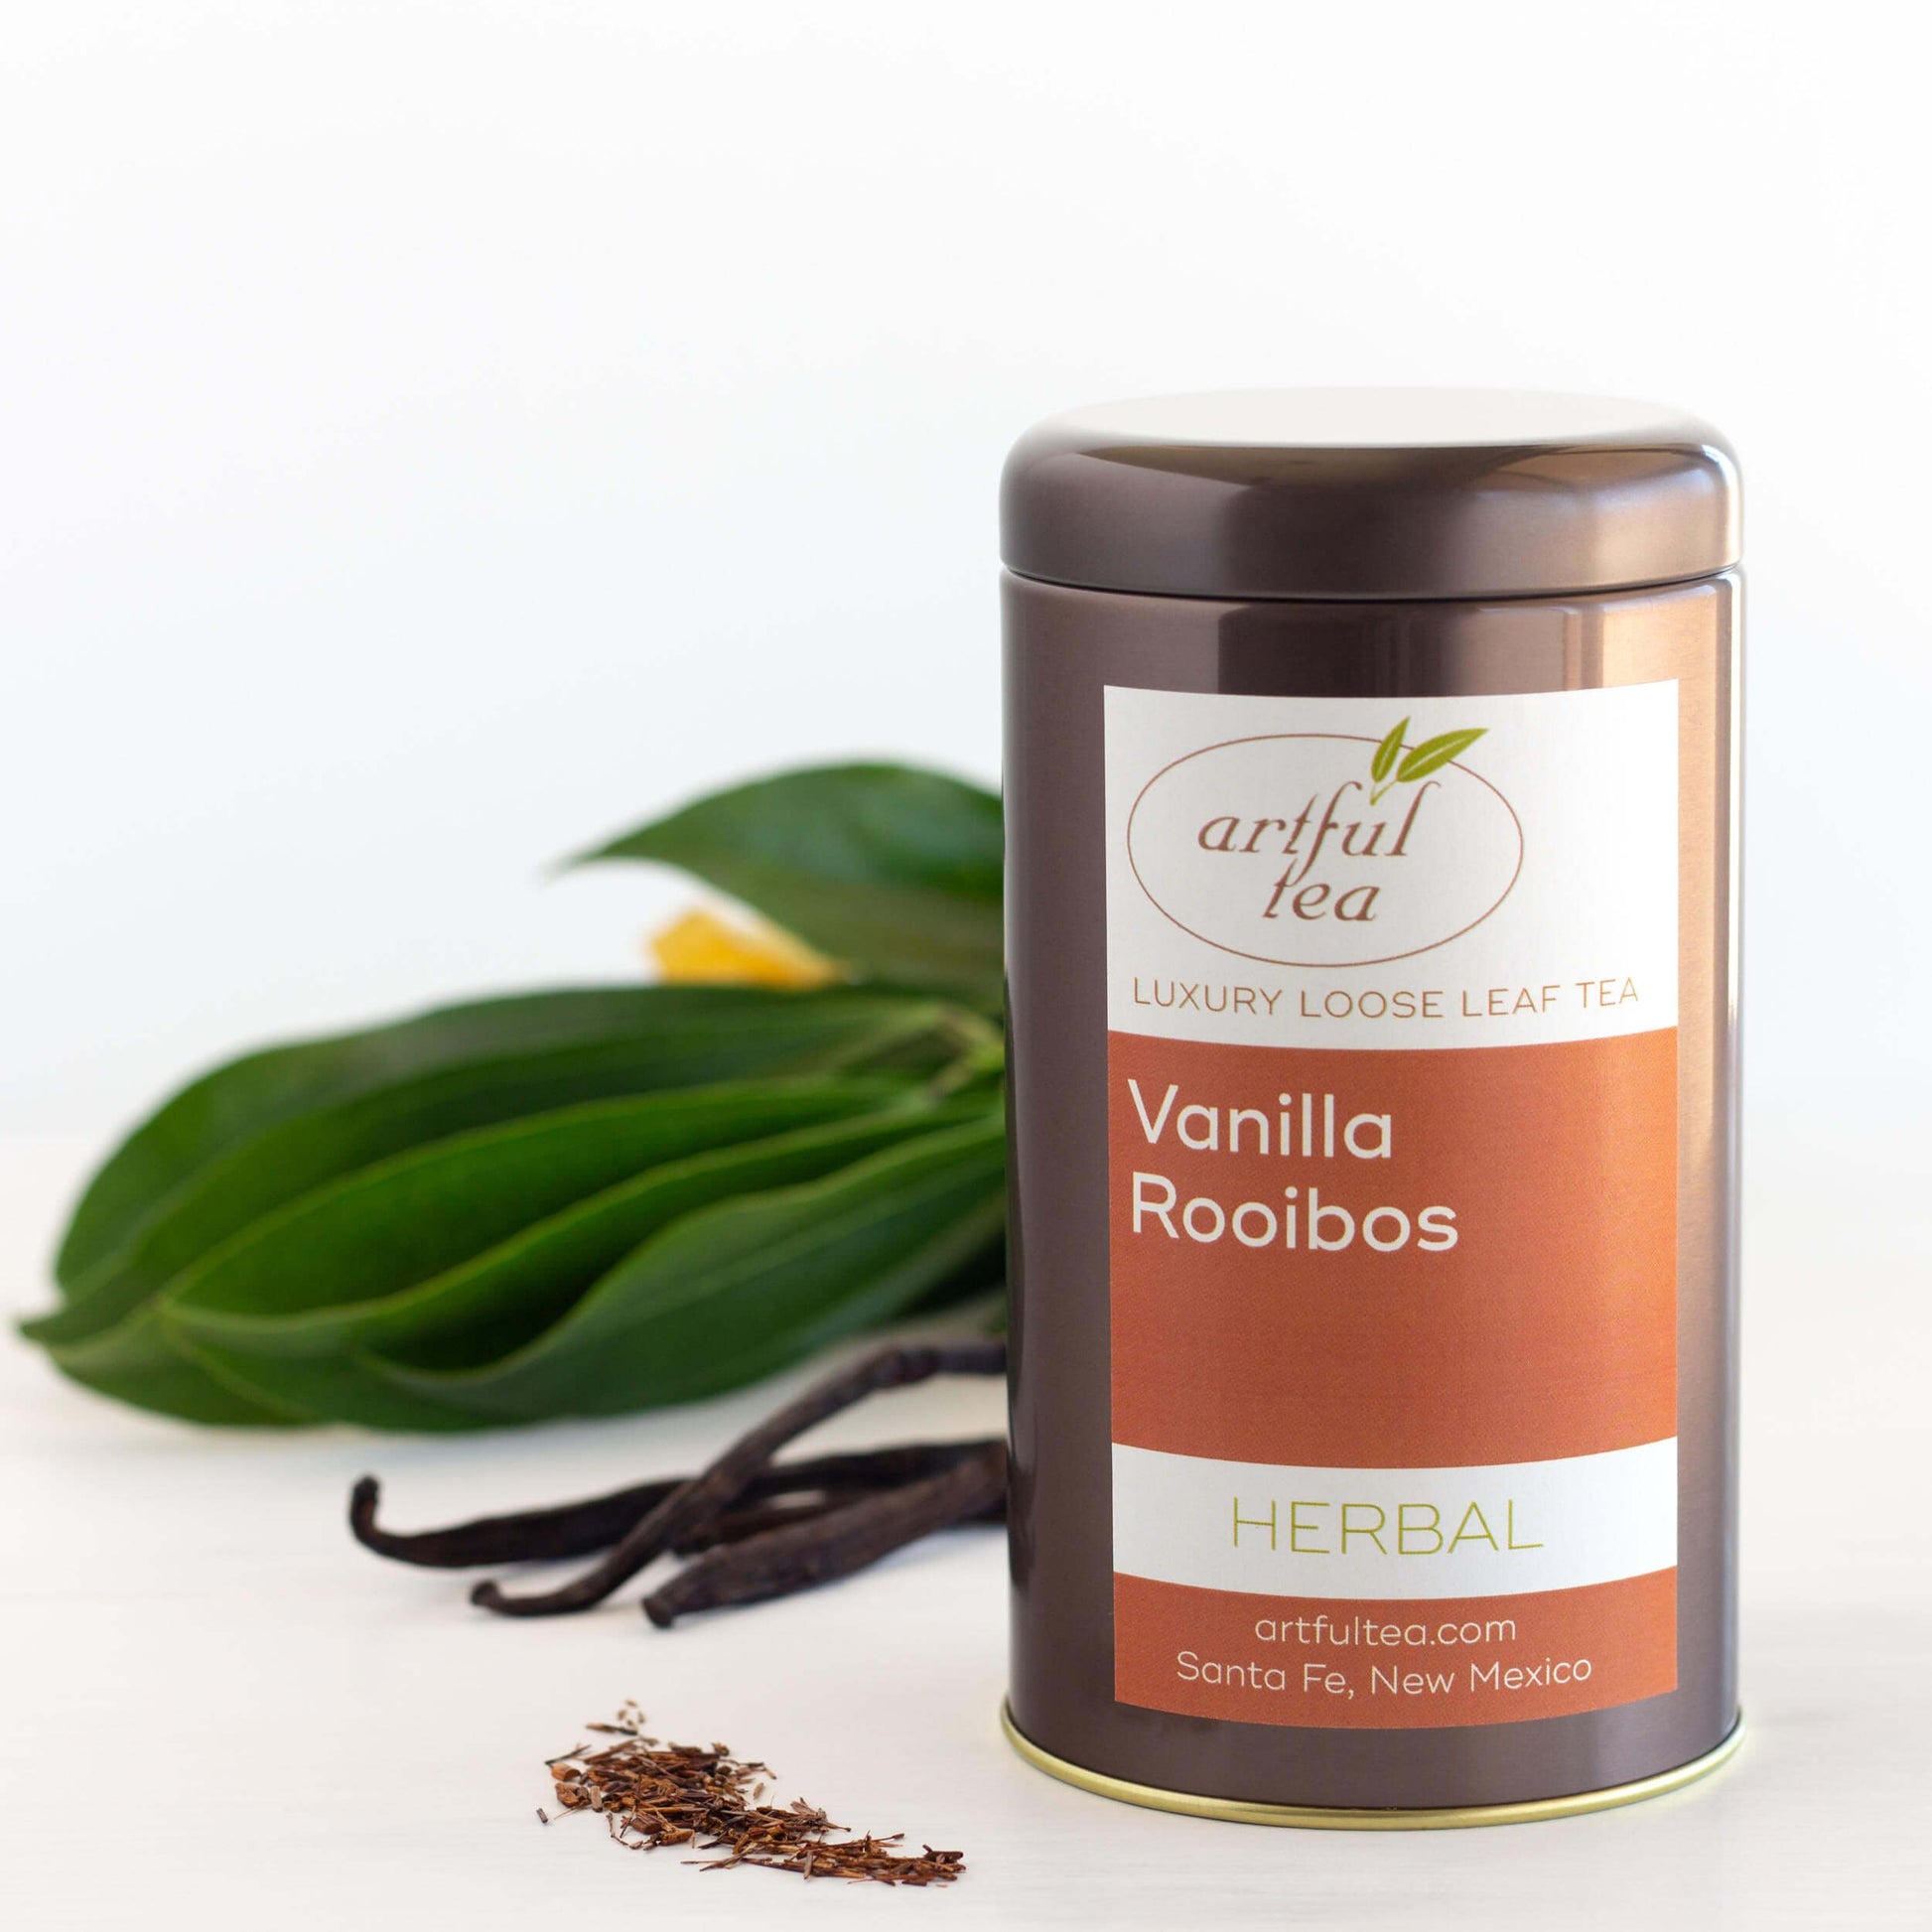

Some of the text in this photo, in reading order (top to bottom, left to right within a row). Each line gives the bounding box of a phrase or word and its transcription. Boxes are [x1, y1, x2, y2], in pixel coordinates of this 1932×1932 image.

[1197, 779, 1441, 885] artful
[1262, 861, 1382, 922] tea
[1133, 976, 1638, 1019] LUXURY LOOSE LEAF TEA
[1127, 1078, 1392, 1160] Vanilla
[1132, 1171, 1459, 1253] Rooibos
[1232, 1496, 1545, 1556] HERBAL
[1254, 1614, 1517, 1647] artfultea.com
[1176, 1650, 1593, 1700] Santa Fe, New Mexico
